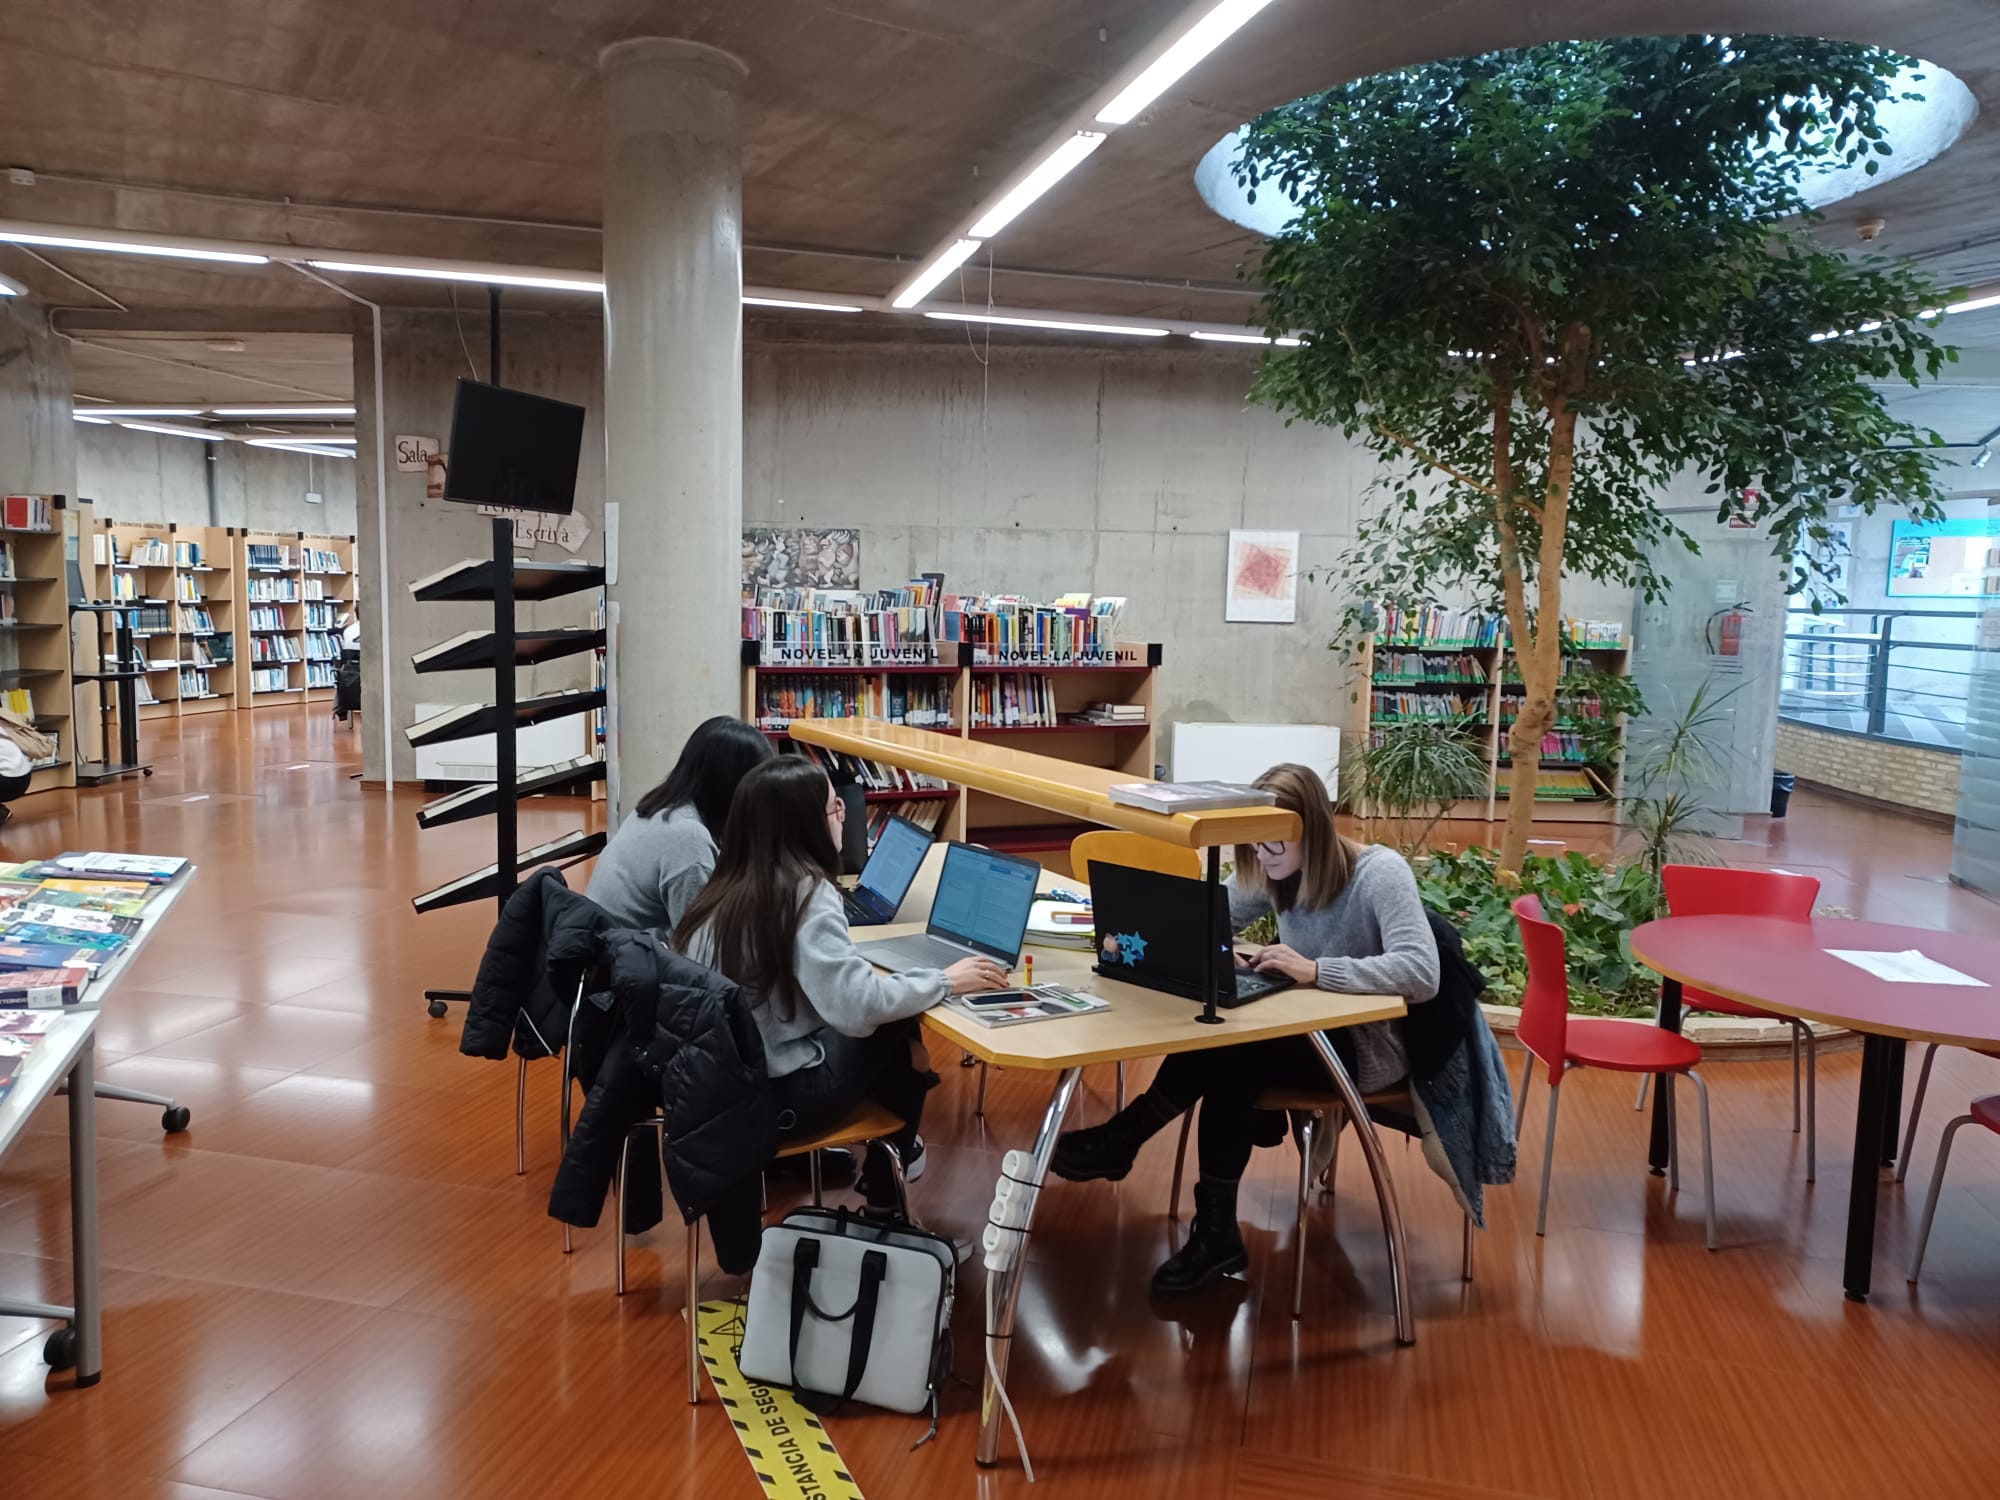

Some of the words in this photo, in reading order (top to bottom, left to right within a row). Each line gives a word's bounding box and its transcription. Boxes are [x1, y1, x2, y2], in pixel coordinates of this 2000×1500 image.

[398, 440, 428, 463] Sala
[514, 519, 569, 542] Escrivà
[871, 648, 939, 660] JUVENIL
[1076, 650, 1137, 661] JUVENIL
[765, 1416, 790, 1436] DE
